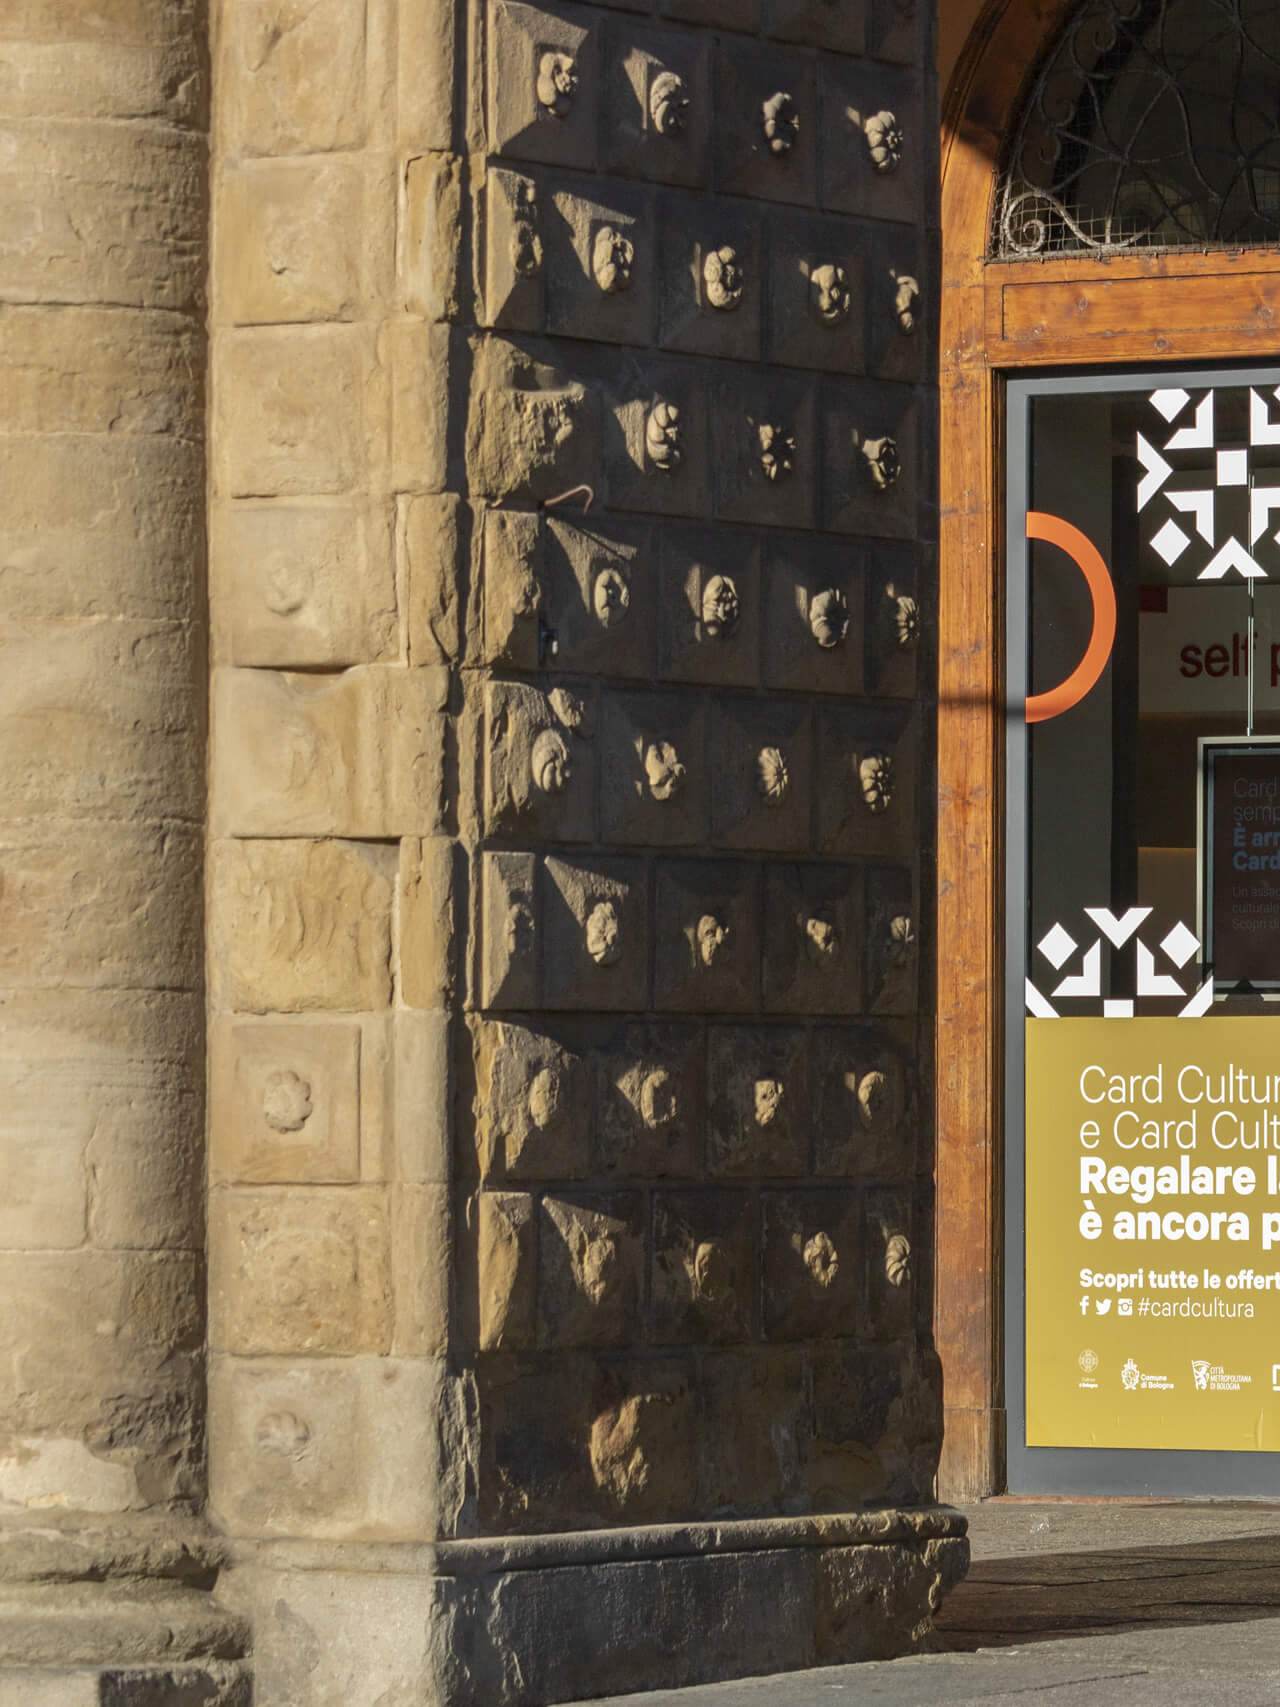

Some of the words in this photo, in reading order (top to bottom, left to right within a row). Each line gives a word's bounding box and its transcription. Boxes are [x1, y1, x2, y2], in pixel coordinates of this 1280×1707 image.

[1179, 632, 1258, 678] self
[1233, 777, 1277, 798] Card
[1233, 824, 1246, 847] È
[1080, 1063, 1163, 1104] Card
[1080, 1120, 1101, 1149] e
[1113, 1109, 1197, 1149] Card
[1079, 1155, 1257, 1204] Regalare
[1079, 1200, 1103, 1240] è
[1112, 1210, 1251, 1242] ancora
[1079, 1268, 1145, 1292] Scopri
[1148, 1271, 1199, 1289] tutte
[1203, 1269, 1221, 1290] le
[1137, 1296, 1255, 1318] #cardcultura
